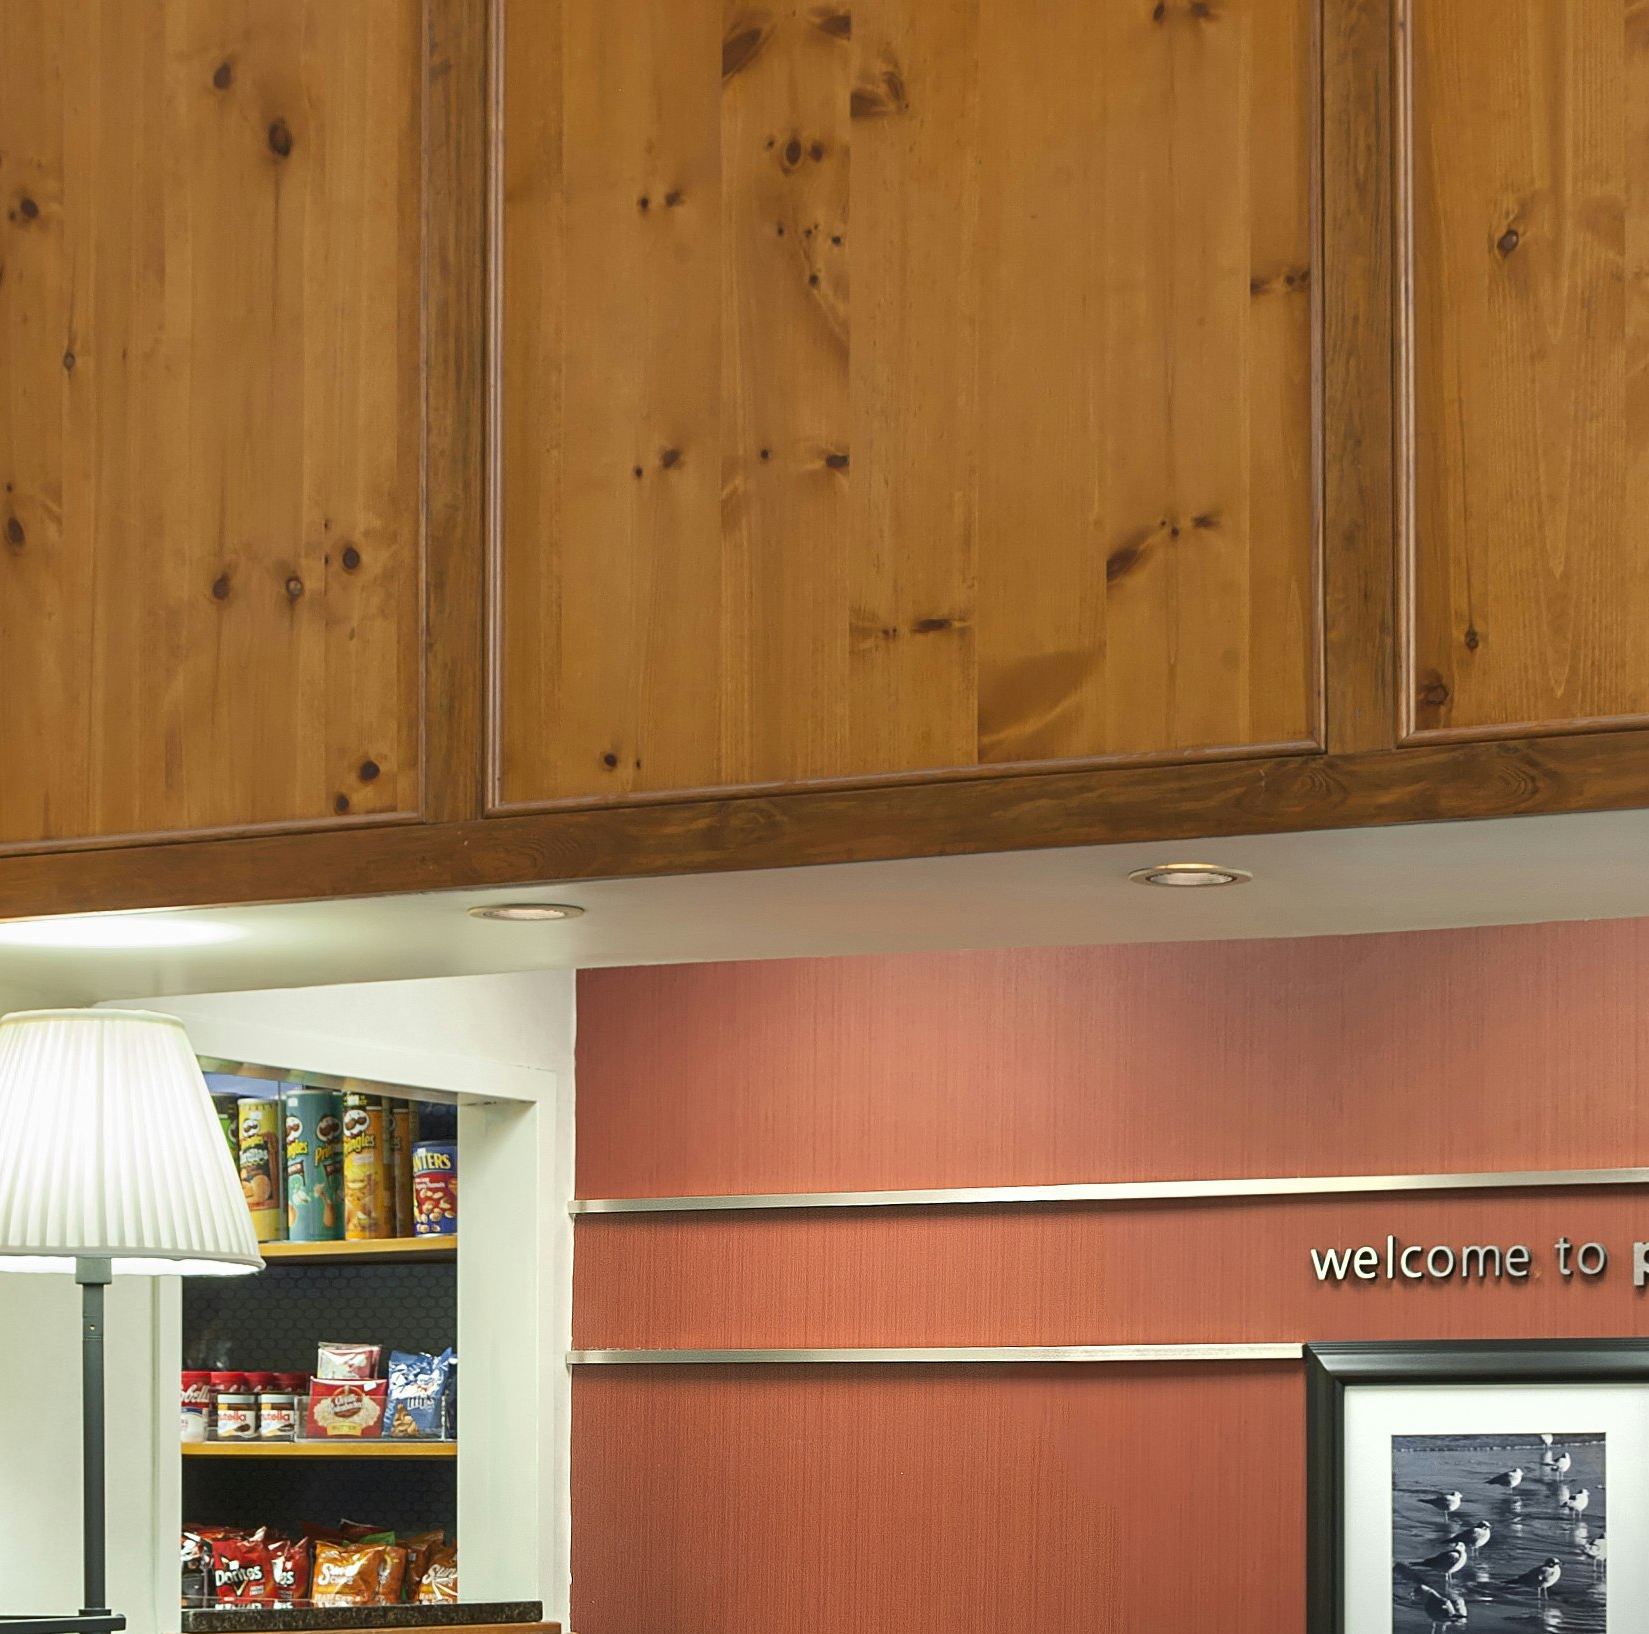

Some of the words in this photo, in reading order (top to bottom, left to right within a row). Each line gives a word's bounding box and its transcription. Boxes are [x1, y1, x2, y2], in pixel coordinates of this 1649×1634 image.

[413, 1152, 452, 1172] NTERS
[1309, 1235, 1531, 1281] welcome
[1554, 1236, 1608, 1277] to
[219, 1410, 247, 1422] utella
[263, 1410, 291, 1422] utella
[215, 1565, 262, 1587] Doritos
